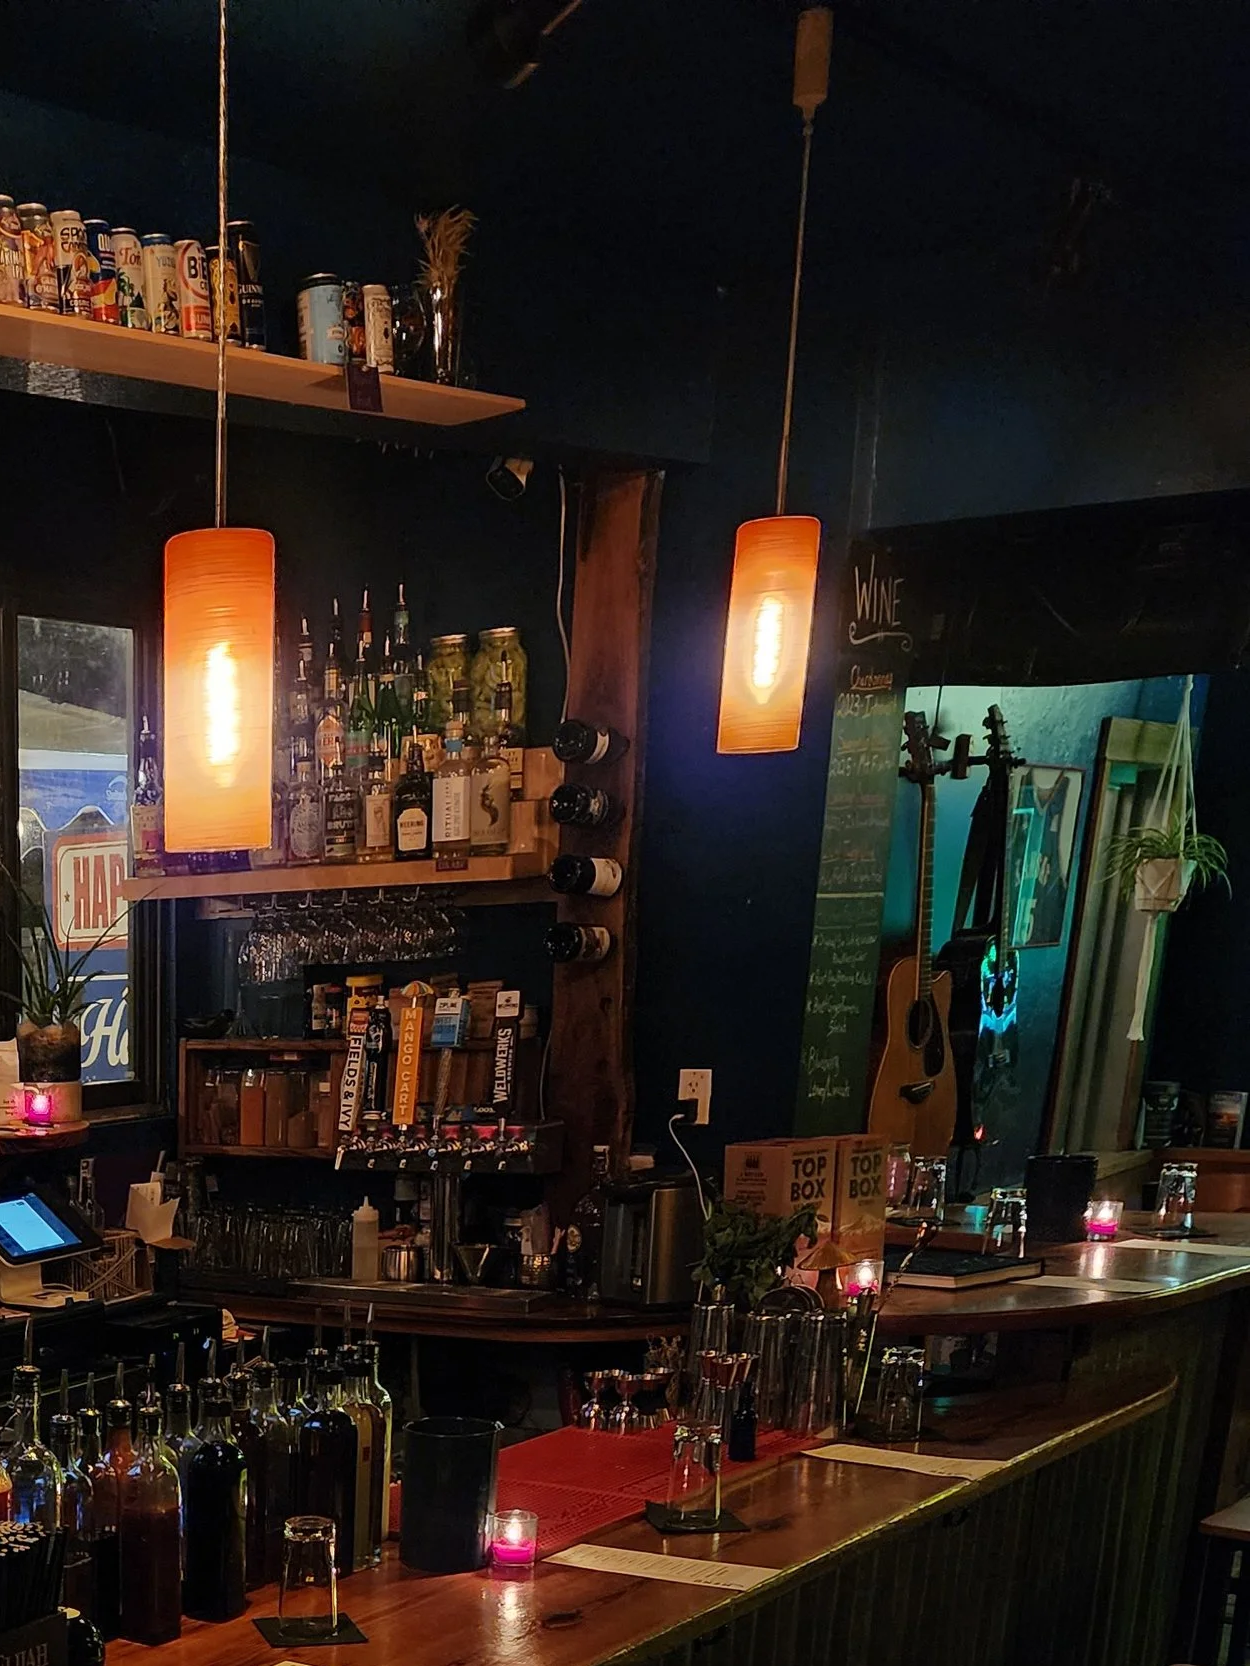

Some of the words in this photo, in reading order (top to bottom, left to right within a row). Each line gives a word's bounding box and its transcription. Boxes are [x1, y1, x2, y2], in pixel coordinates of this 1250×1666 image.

[854, 555, 903, 628] WINE
[73, 854, 126, 930] HAP
[402, 1009, 417, 1065] MANGO
[344, 1036, 363, 1088] FIELDS
[492, 1028, 513, 1104] WELDWERKS
[398, 1071, 413, 1115] CART
[340, 1104, 354, 1128] IVY
[792, 1156, 827, 1179] TOP
[850, 1154, 882, 1175] TOP
[790, 1178, 826, 1202] BOX
[849, 1176, 881, 1199] BOX
